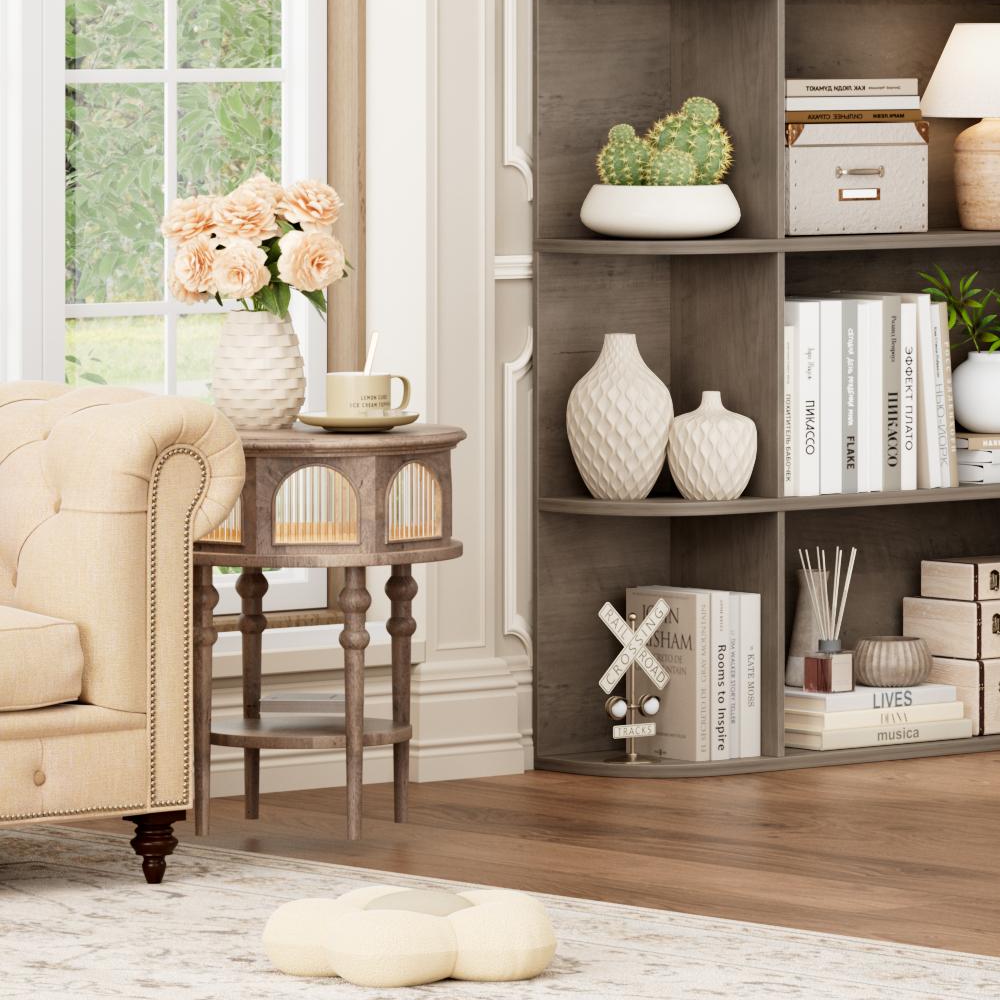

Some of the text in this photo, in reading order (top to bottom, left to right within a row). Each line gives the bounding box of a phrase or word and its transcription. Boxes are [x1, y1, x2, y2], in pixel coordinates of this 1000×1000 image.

[905, 346, 914, 451] ЭФФЕКТ ПЛАТО
[806, 400, 815, 456] ПИКАССО
[846, 436, 855, 470] FLAKE
[888, 392, 898, 468] ПИКАССО
[605, 608, 666, 685] RAIL ROAD
[606, 608, 664, 685] CROSSING
[716, 644, 726, 751] Rooms to Inspire
[748, 654, 756, 708] KATE MOSS
[873, 690, 912, 709] LIVES
[618, 725, 652, 737] TRACKS
[877, 727, 920, 742] musica
